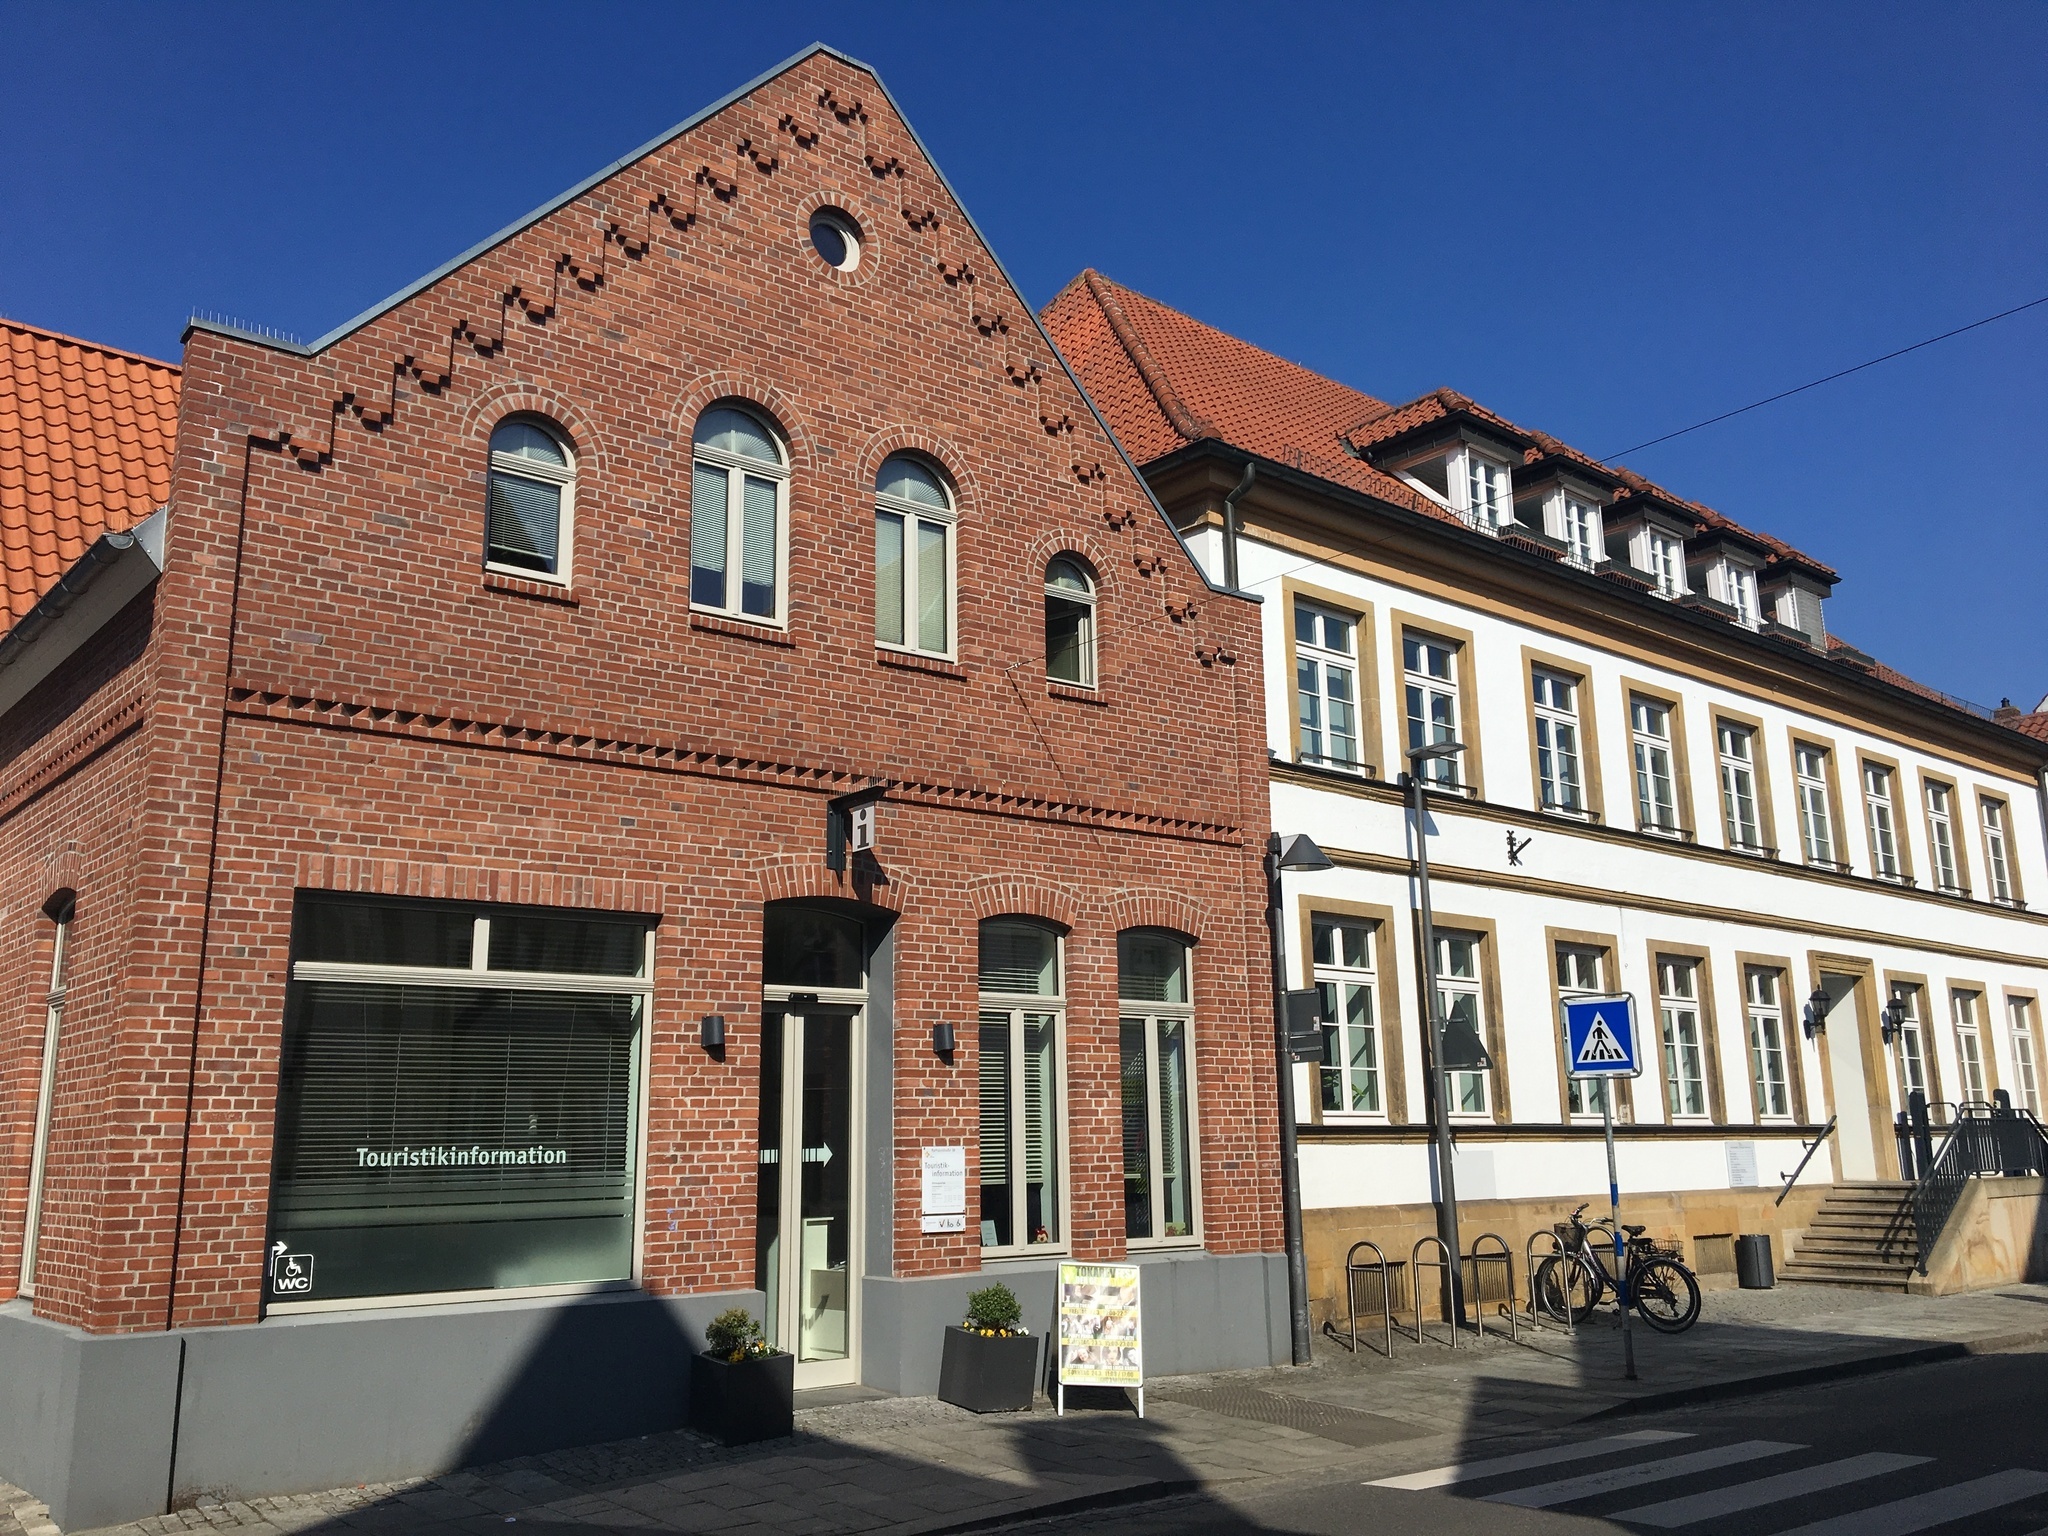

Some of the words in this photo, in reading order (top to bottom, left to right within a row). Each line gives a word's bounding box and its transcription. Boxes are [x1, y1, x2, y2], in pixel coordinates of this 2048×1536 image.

[857, 808, 870, 849] i
[356, 1145, 567, 1167] Touristikinformation
[925, 1162, 950, 1170] Touristik-
[277, 1277, 308, 1291] WC
